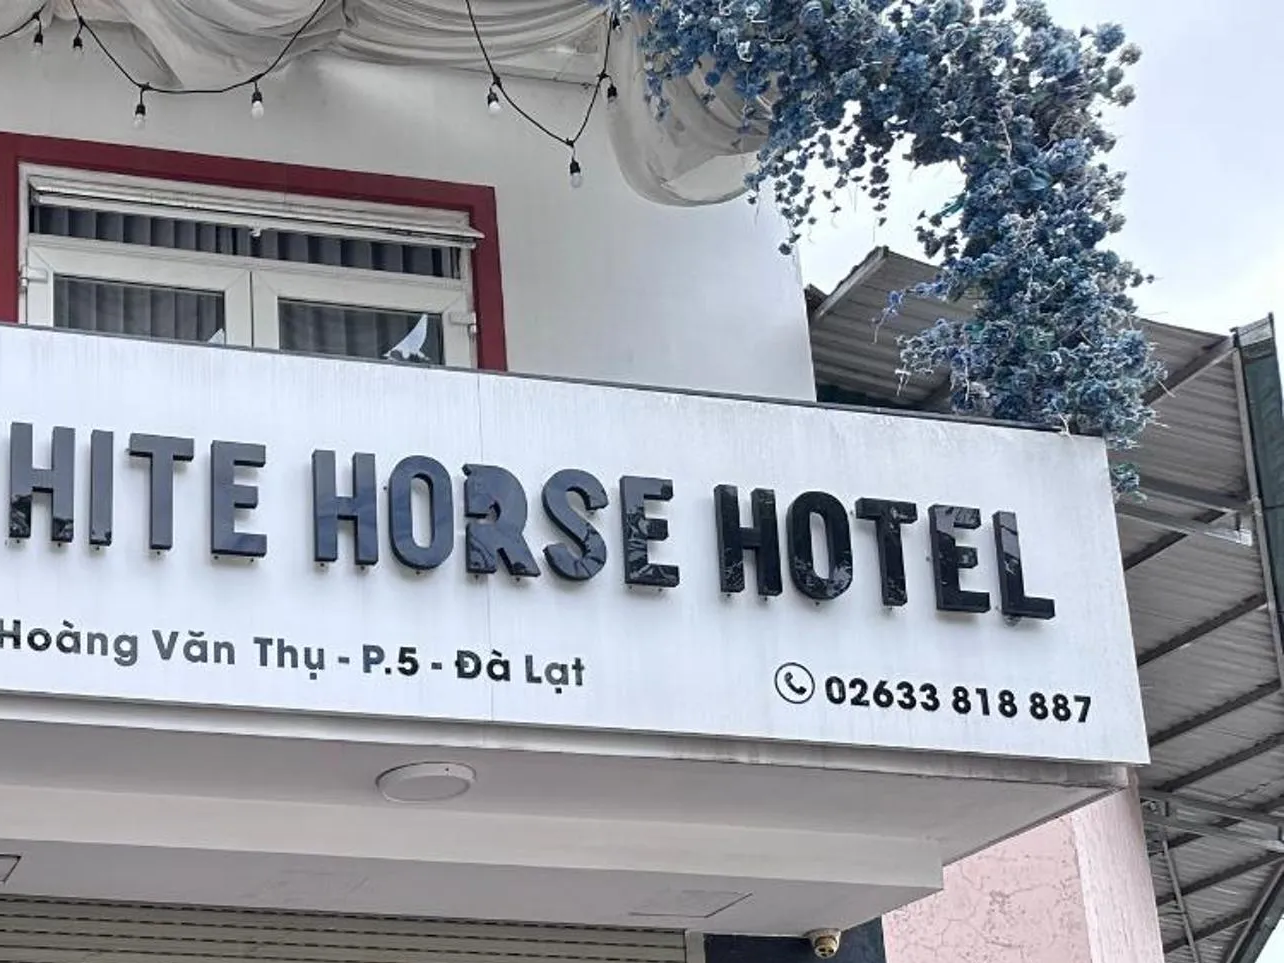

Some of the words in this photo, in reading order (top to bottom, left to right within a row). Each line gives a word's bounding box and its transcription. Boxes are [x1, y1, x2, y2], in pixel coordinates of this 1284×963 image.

[312, 449, 681, 589] HORSE
[714, 484, 1056, 622] HOTEL
[152, 629, 235, 665] Văn
[253, 636, 325, 680] Thụ
[362, 644, 420, 677] P.5
[454, 649, 511, 682] Đà
[525, 654, 585, 695] Lạt
[824, 675, 941, 712] 02633
[951, 685, 1018, 719] 818
[1029, 691, 1092, 723] 887
